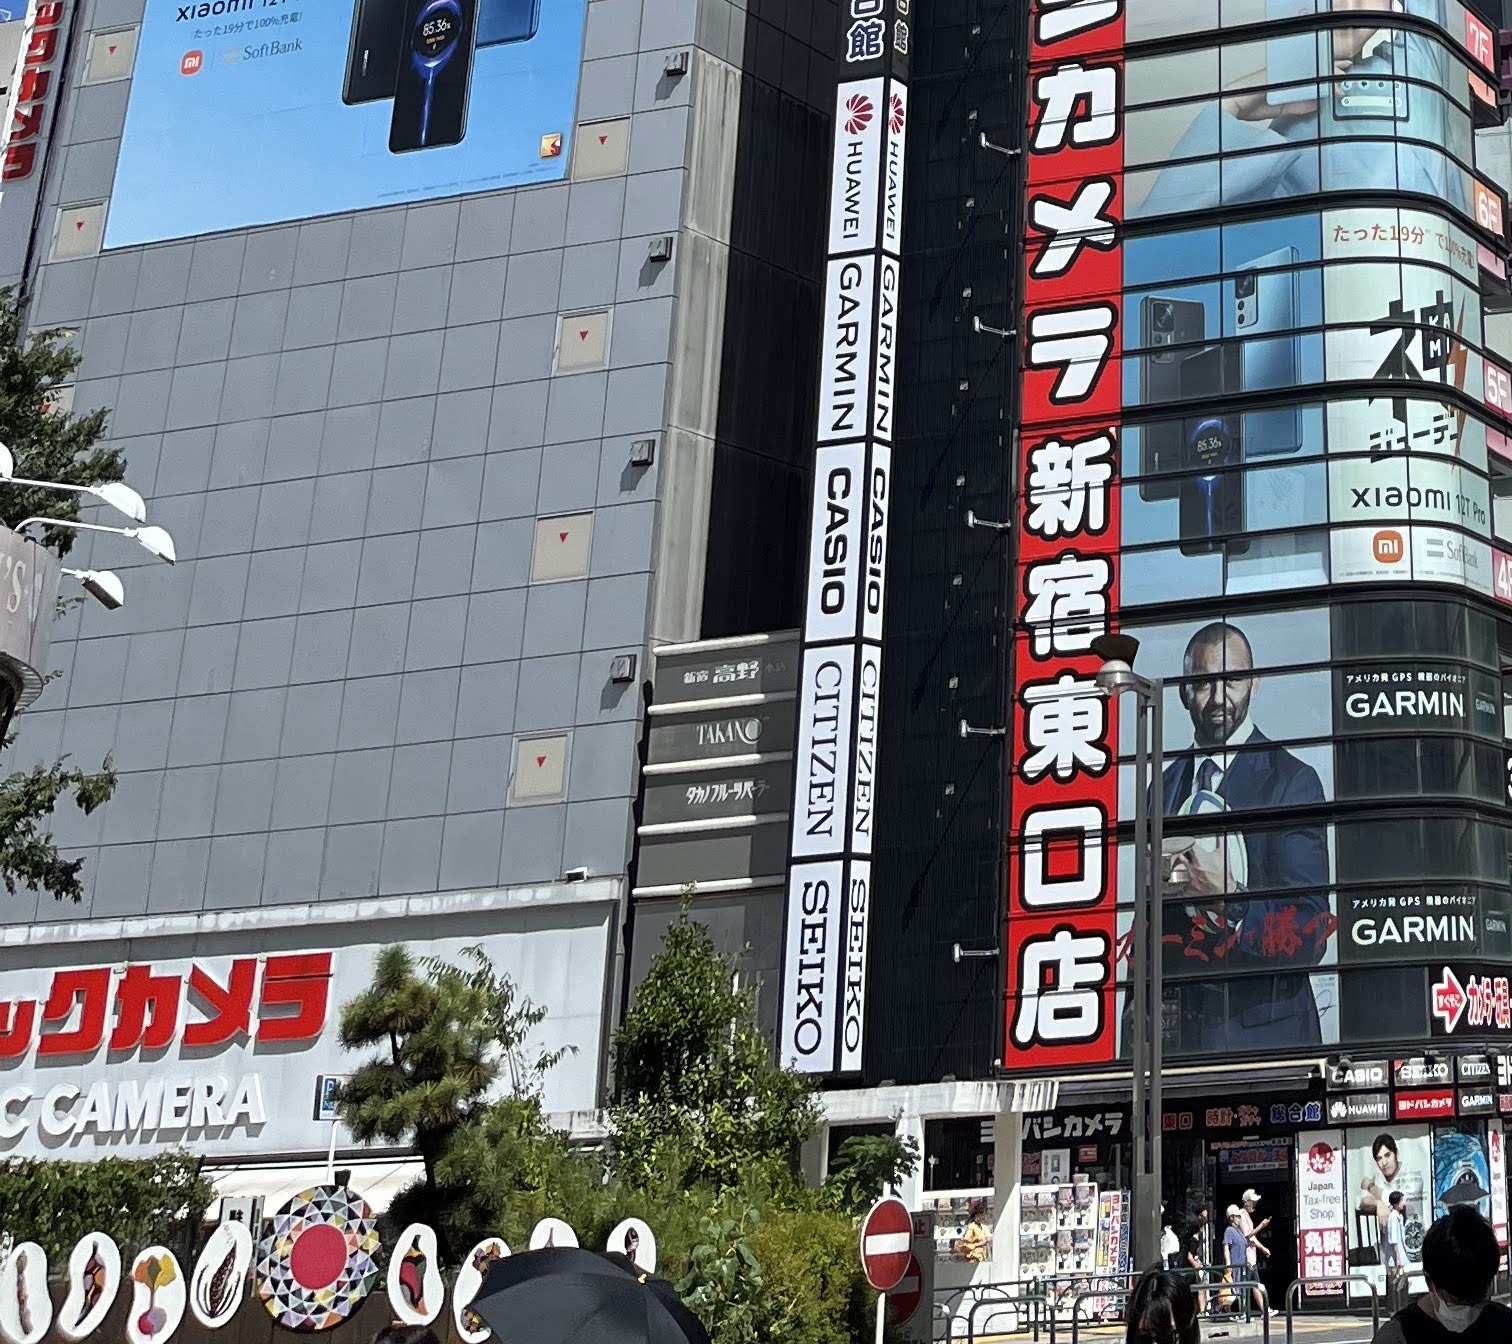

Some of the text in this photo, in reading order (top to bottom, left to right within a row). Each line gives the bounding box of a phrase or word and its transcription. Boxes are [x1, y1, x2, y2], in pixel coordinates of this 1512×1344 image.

[243, 37, 303, 61] SoftBank
[1469, 20, 1489, 63] 7F
[843, 142, 863, 239] HUAWEI
[886, 142, 898, 240] HUAWEI
[1477, 191, 1499, 236] 6F
[831, 262, 862, 432] GARMIN
[875, 264, 895, 433] GARMIN
[1486, 365, 1508, 412] 5F
[1351, 486, 1450, 511] xiaomi
[1473, 502, 1486, 526] Pro
[820, 467, 851, 615] CASIO
[866, 467, 885, 615] CASIO
[1392, 671, 1412, 682] GPS
[1346, 690, 1465, 718] GARMIN
[697, 718, 763, 745] TAKANO
[806, 660, 842, 838] CITIZEN
[854, 658, 877, 838] CITIZEN
[1399, 896, 1421, 906] GPS
[1352, 915, 1476, 945] GARMIN
[794, 879, 829, 1055] SEIKO
[845, 878, 867, 1053] SEIKO
[1333, 1066, 1383, 1084] CASIO
[1399, 1065, 1449, 1079] SEIKO
[41, 1073, 266, 1136] CAMERA
[1349, 1103, 1387, 1115] HUAWEI
[1398, 1097, 1452, 1110] ヨドバシカメラ
[1461, 1095, 1493, 1107] GARMIN
[1303, 1194, 1341, 1205] Tax-free
[1310, 1209, 1335, 1221] Shop
